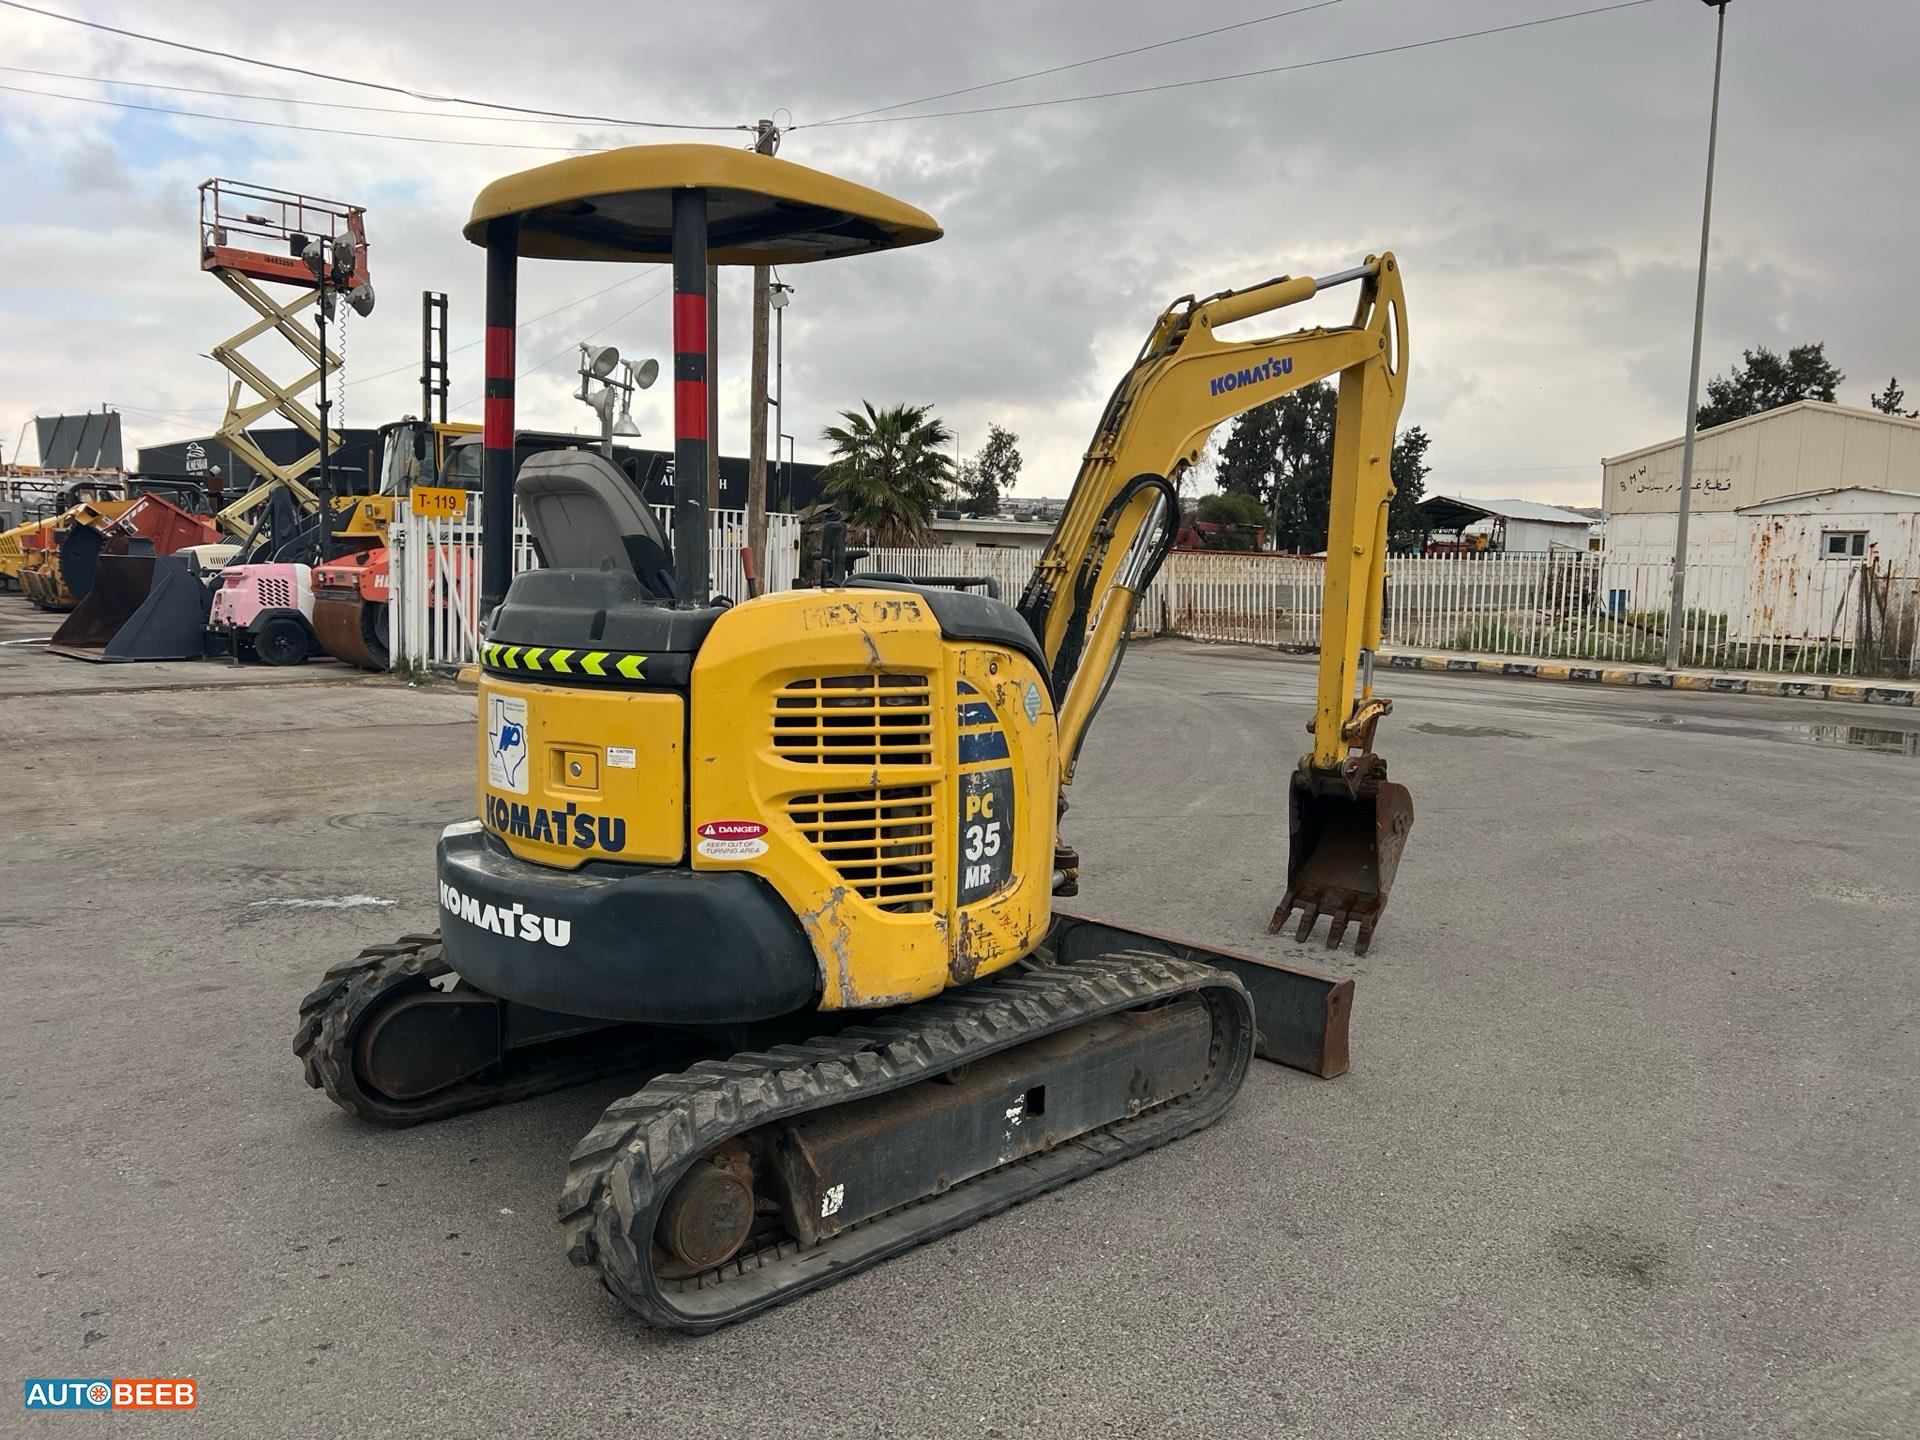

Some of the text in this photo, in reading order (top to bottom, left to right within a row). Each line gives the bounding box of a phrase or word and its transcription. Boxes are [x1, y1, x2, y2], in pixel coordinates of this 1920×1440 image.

[1210, 357, 1293, 397] KOMATSU
[486, 793, 626, 852] KOMATSU
[966, 793, 994, 821] PC
[965, 821, 1000, 862] 35
[964, 864, 991, 890] MR
[440, 878, 571, 947] KOMATSU
